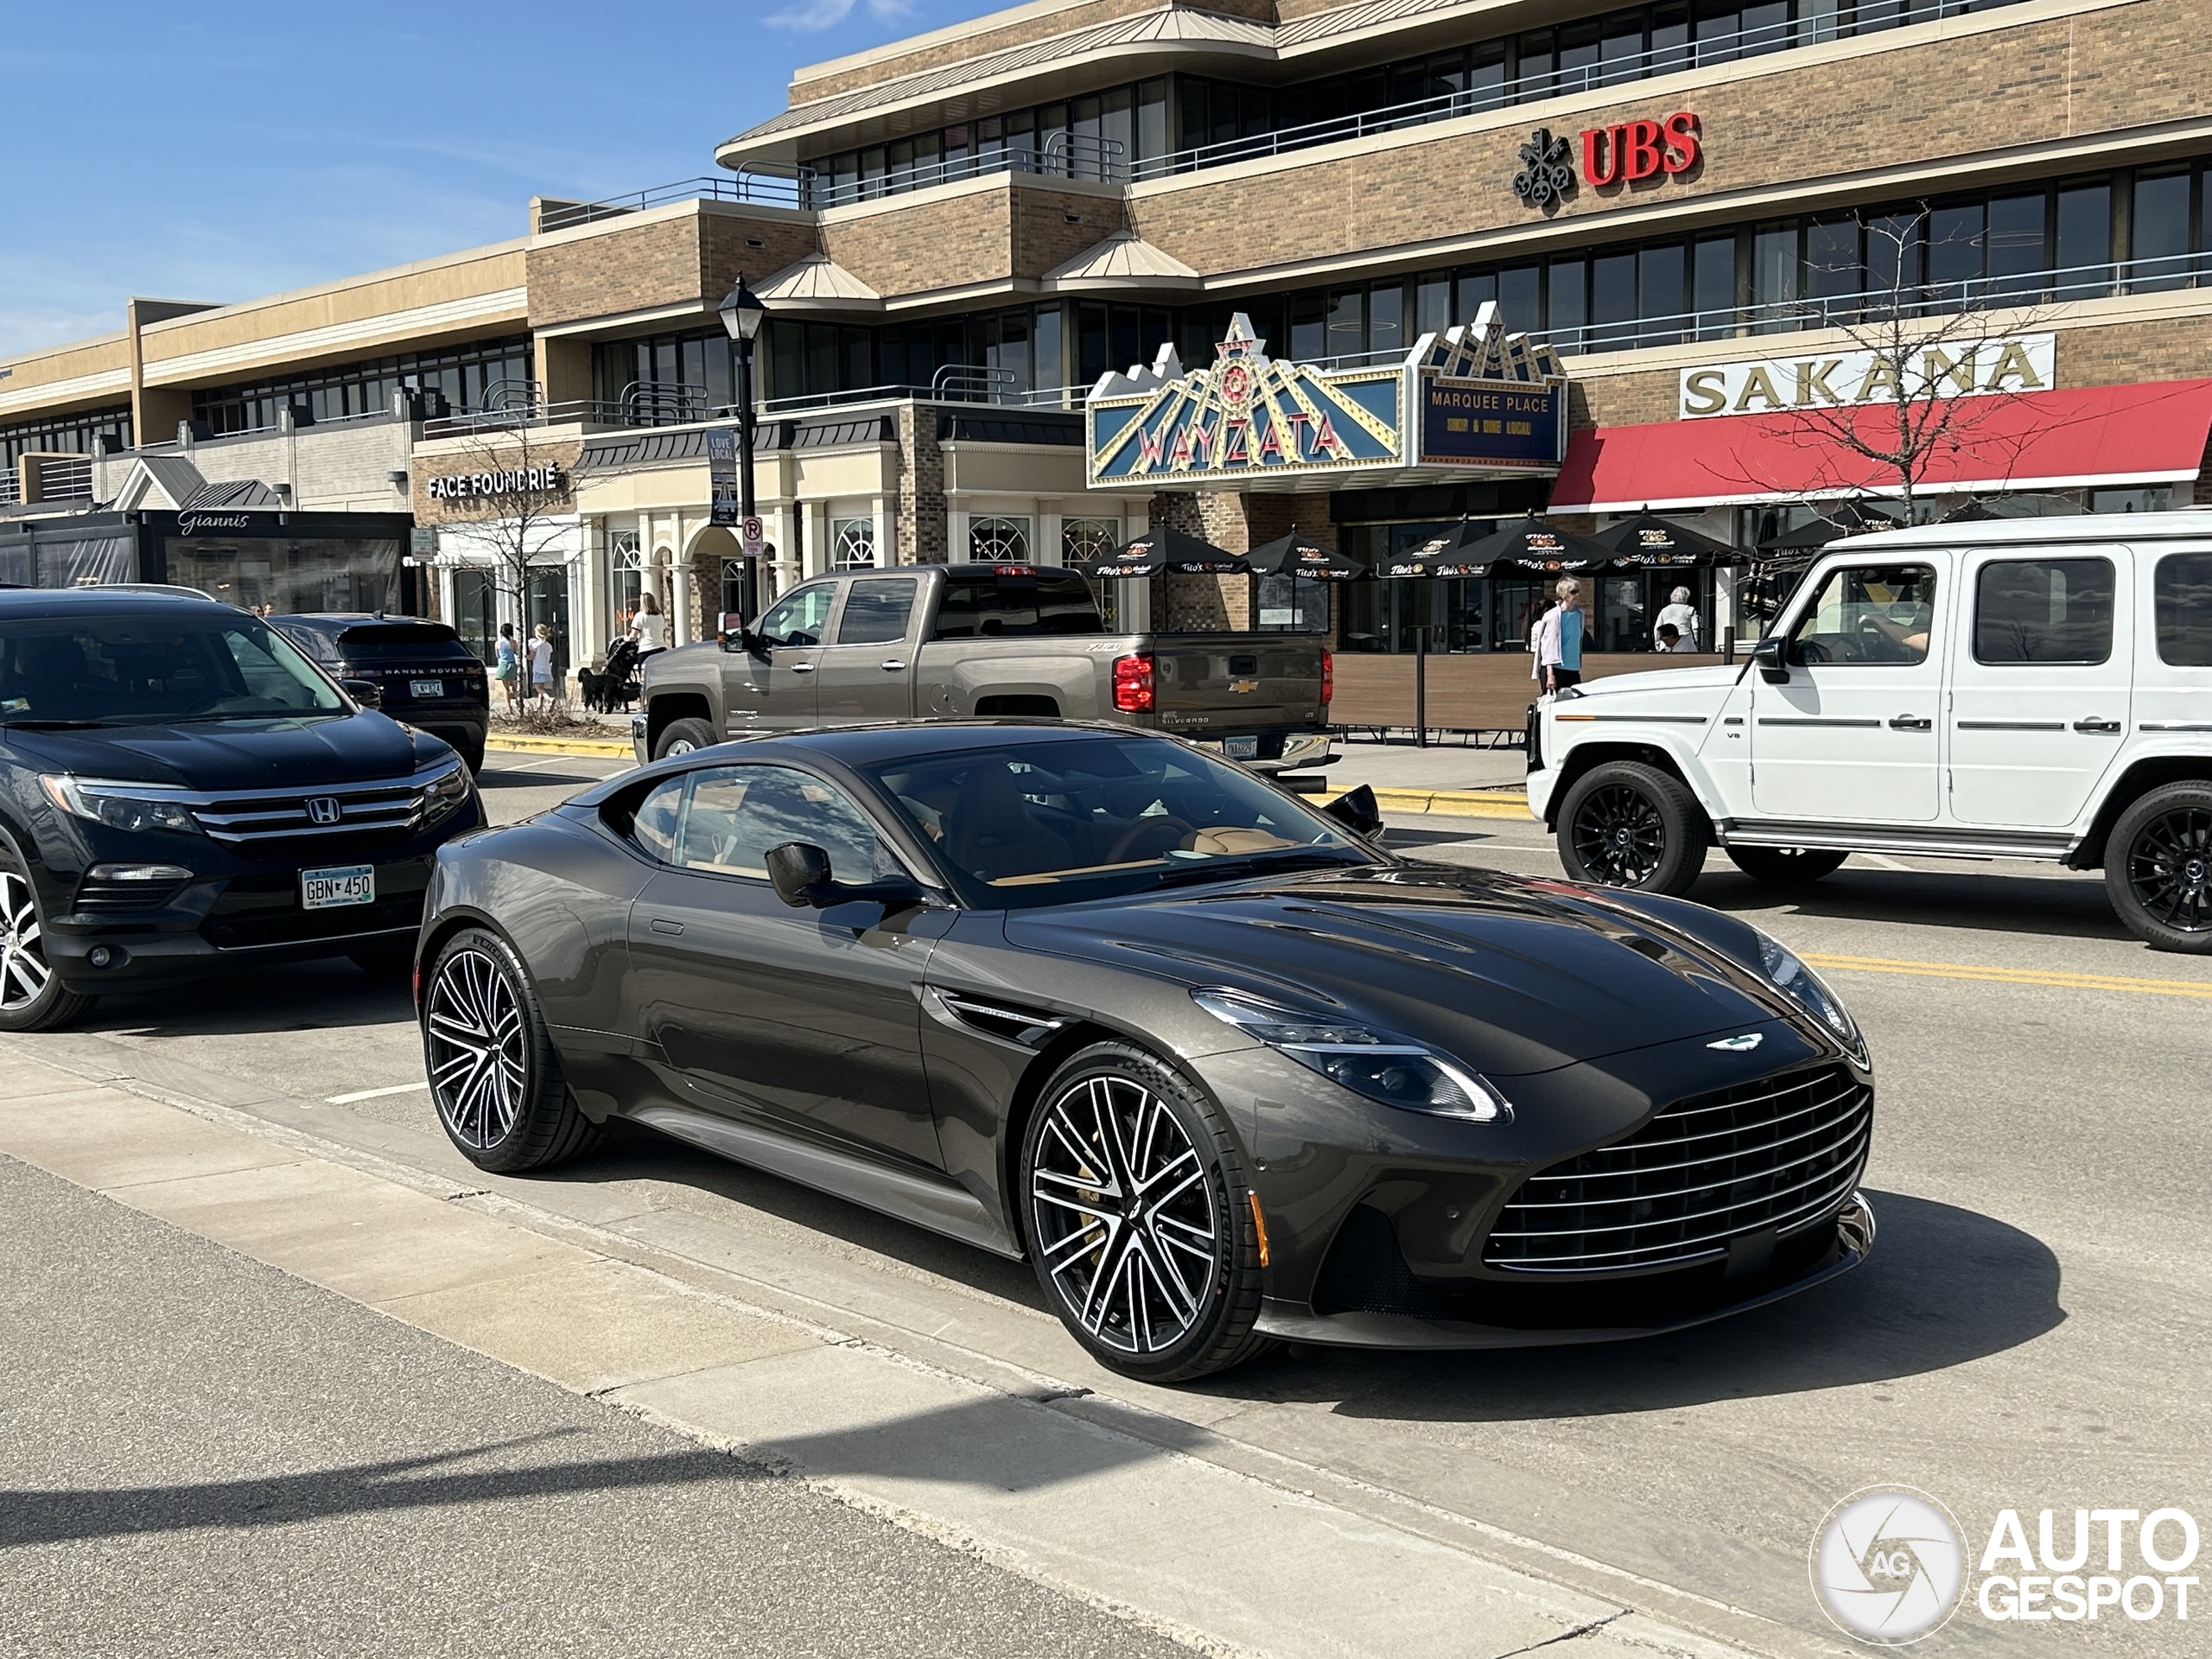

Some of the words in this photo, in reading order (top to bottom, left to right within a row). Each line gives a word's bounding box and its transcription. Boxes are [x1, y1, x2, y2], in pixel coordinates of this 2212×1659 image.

[1580, 112, 1700, 187] UBS
[1685, 340, 2045, 415] SAKANA
[1432, 391, 1500, 410] MARQUEE
[1507, 397, 1549, 413] PLACE
[1447, 418, 1469, 432] SHOP
[1473, 419, 1479, 433] &
[1483, 419, 1502, 434] DINE
[1506, 421, 1532, 435] LOCAL
[711, 437, 731, 449] LOVE
[1137, 409, 1341, 467] WAYZATA
[710, 448, 734, 461] LOCAL
[428, 477, 467, 499] FACE
[177, 510, 250, 536] Giannis
[1774, 548, 1801, 557] Tito's
[1096, 565, 1122, 576] Tito's
[1181, 563, 1205, 572] Tito's
[1295, 569, 1319, 577] Tito's
[1390, 563, 1414, 575] Tito's
[1436, 564, 1459, 576] Tito's
[307, 879, 334, 900] GBN
[344, 875, 371, 896] 450
[1217, 1190, 1231, 1286] MICHELIN
